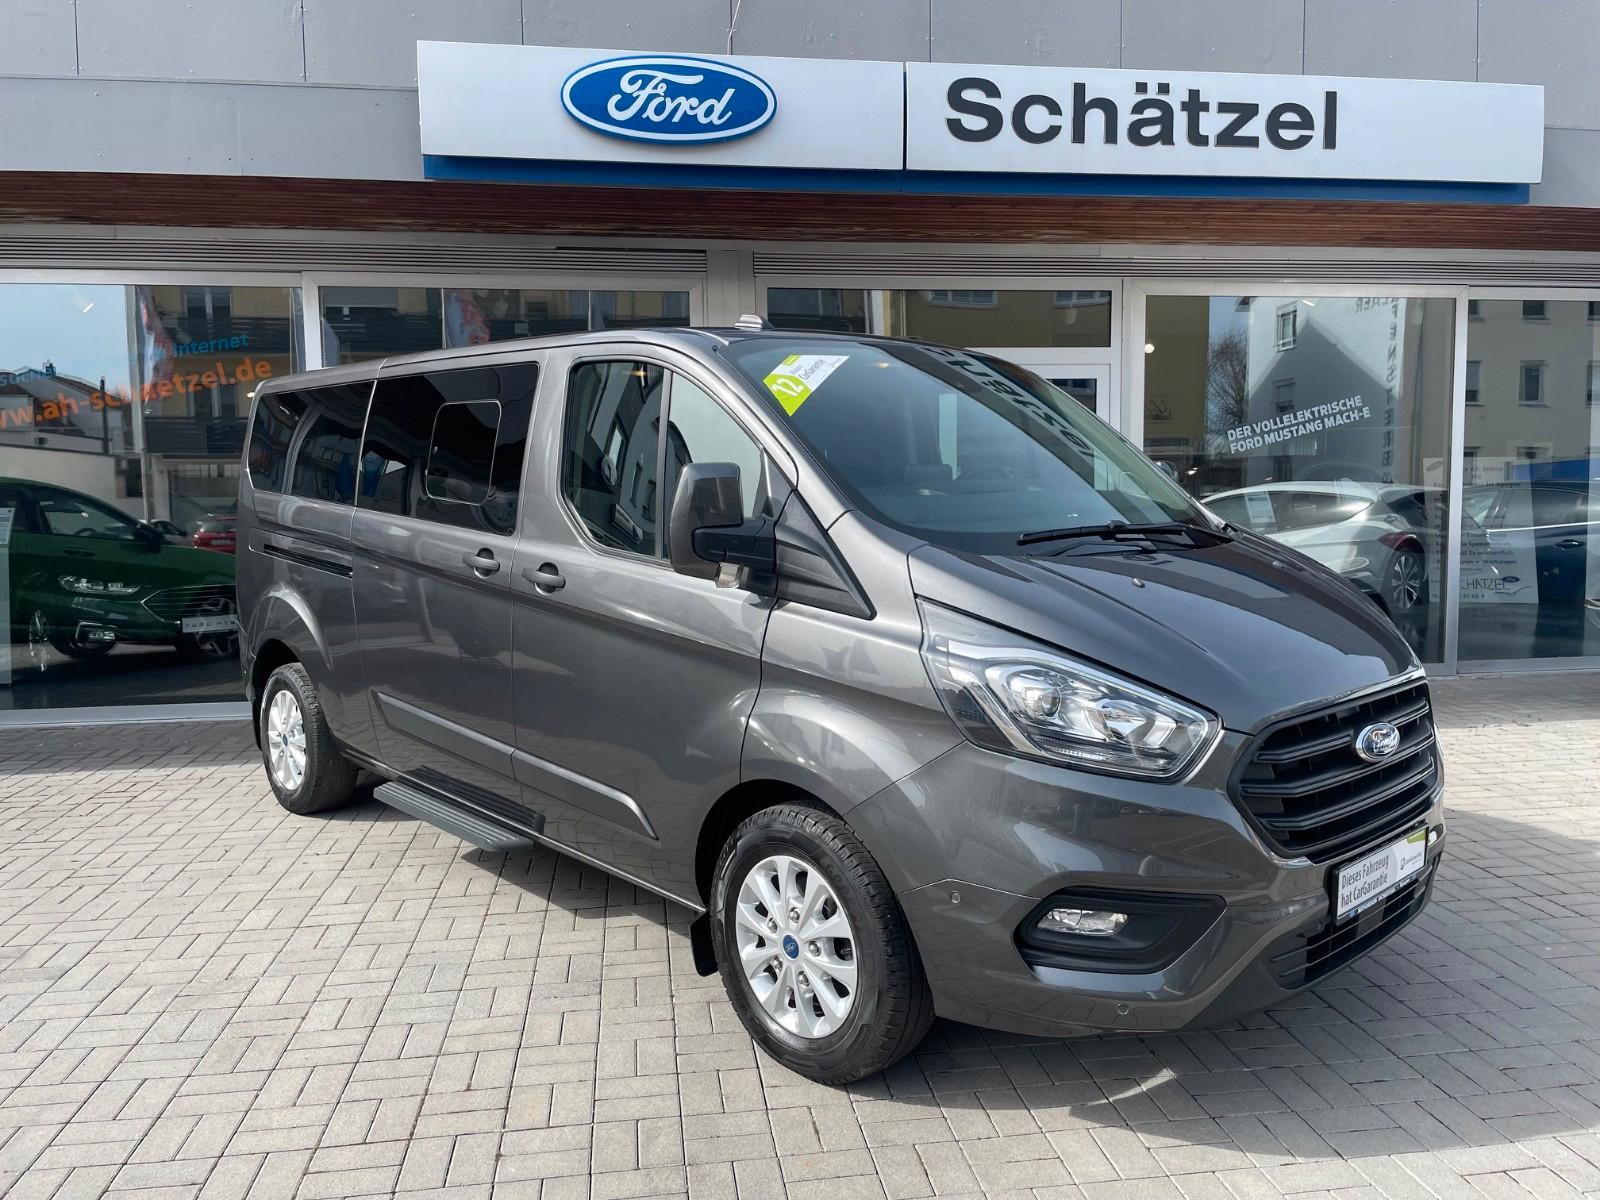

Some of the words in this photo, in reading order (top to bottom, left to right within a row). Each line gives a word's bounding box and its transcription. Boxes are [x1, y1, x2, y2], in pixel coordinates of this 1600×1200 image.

[607, 69, 736, 126] Ford
[946, 76, 1338, 151] Schätzel
[771, 378, 805, 397] 12
[1227, 426, 1252, 441] DER
[1253, 395, 1363, 434] VOLLELEKTRISCHE
[1230, 437, 1263, 454] FORD
[1264, 419, 1323, 446] MUSTANG
[1324, 406, 1371, 429] MACH-E
[1341, 868, 1362, 890] Dieses
[1362, 855, 1389, 878] Fahrzeug
[1341, 891, 1352, 908] hat
[1353, 870, 1388, 900] CarGarantie
